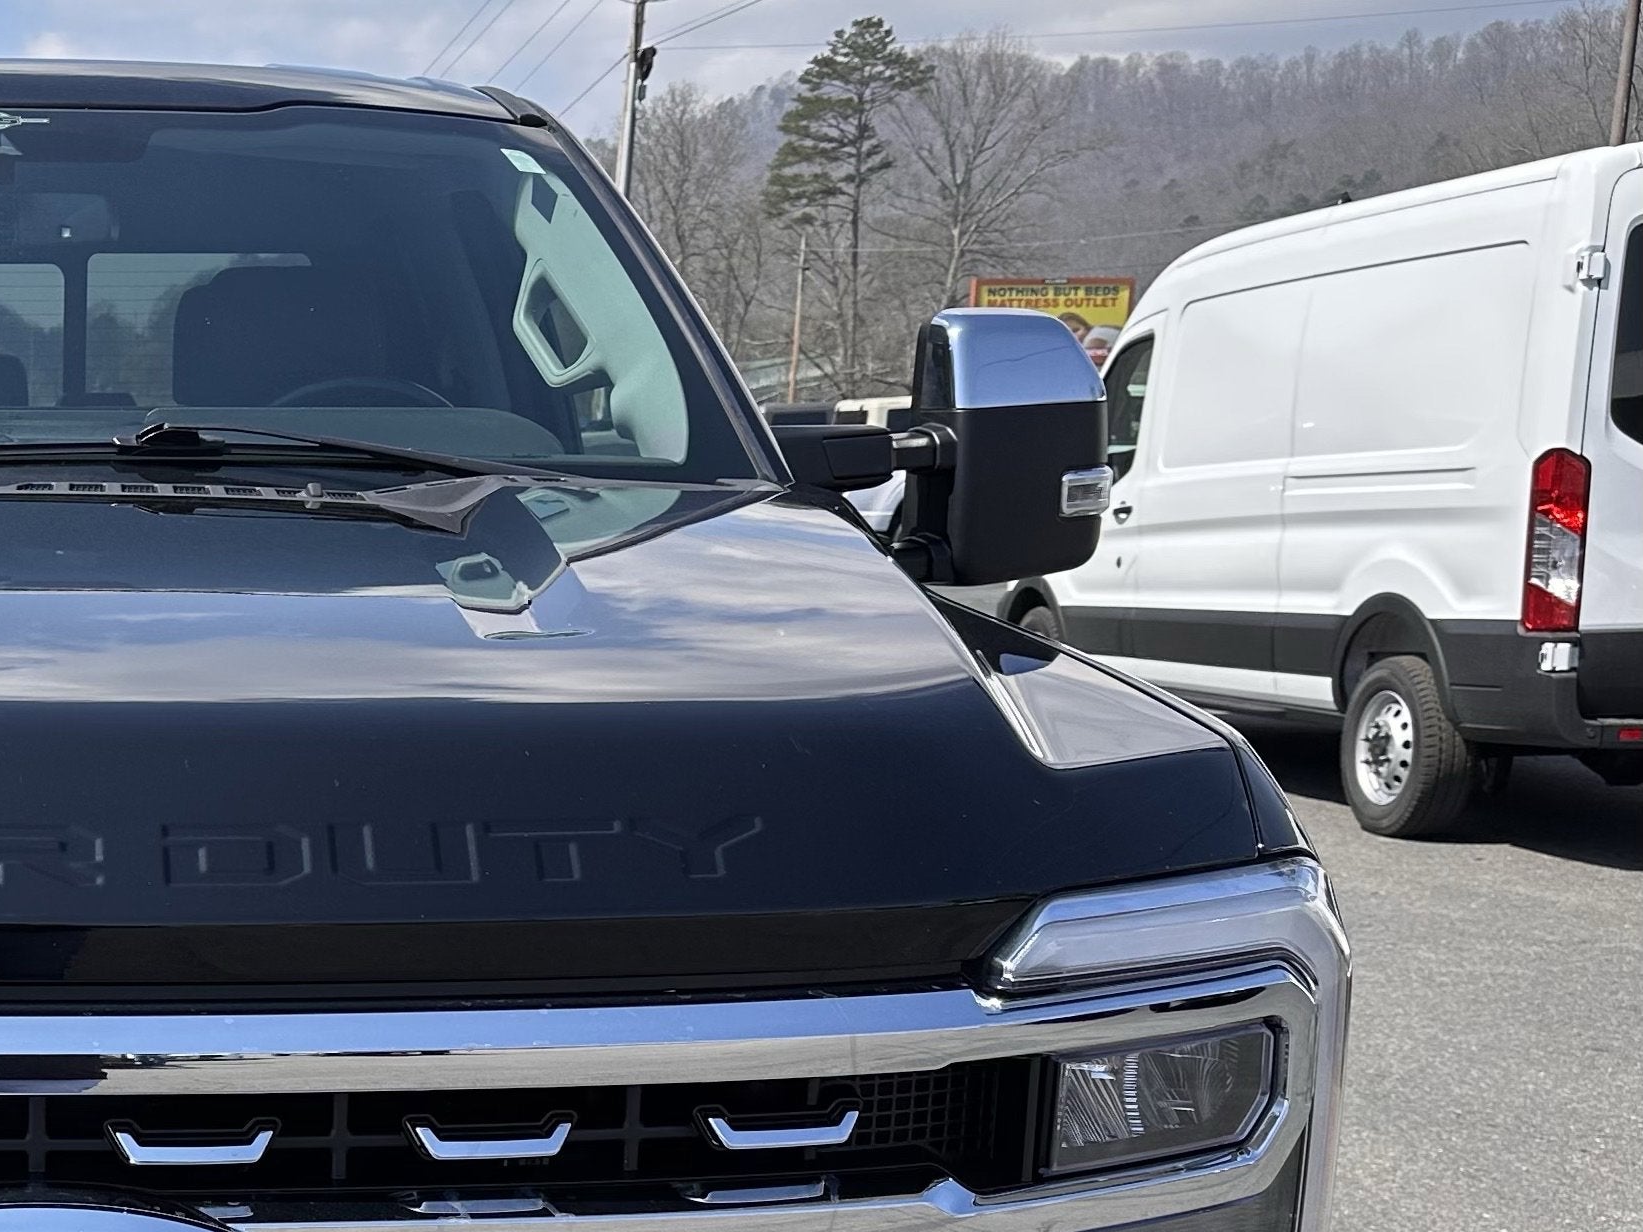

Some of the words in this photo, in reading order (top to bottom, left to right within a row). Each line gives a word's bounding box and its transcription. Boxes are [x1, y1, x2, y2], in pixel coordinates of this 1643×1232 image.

[987, 286, 1048, 296] NOTHING
[1053, 286, 1079, 296] BUT
[1085, 285, 1120, 296] BEDS
[987, 298, 1060, 308] MATTRESS
[1063, 297, 1118, 308] OUTLET
[160, 812, 763, 887] DUTY
